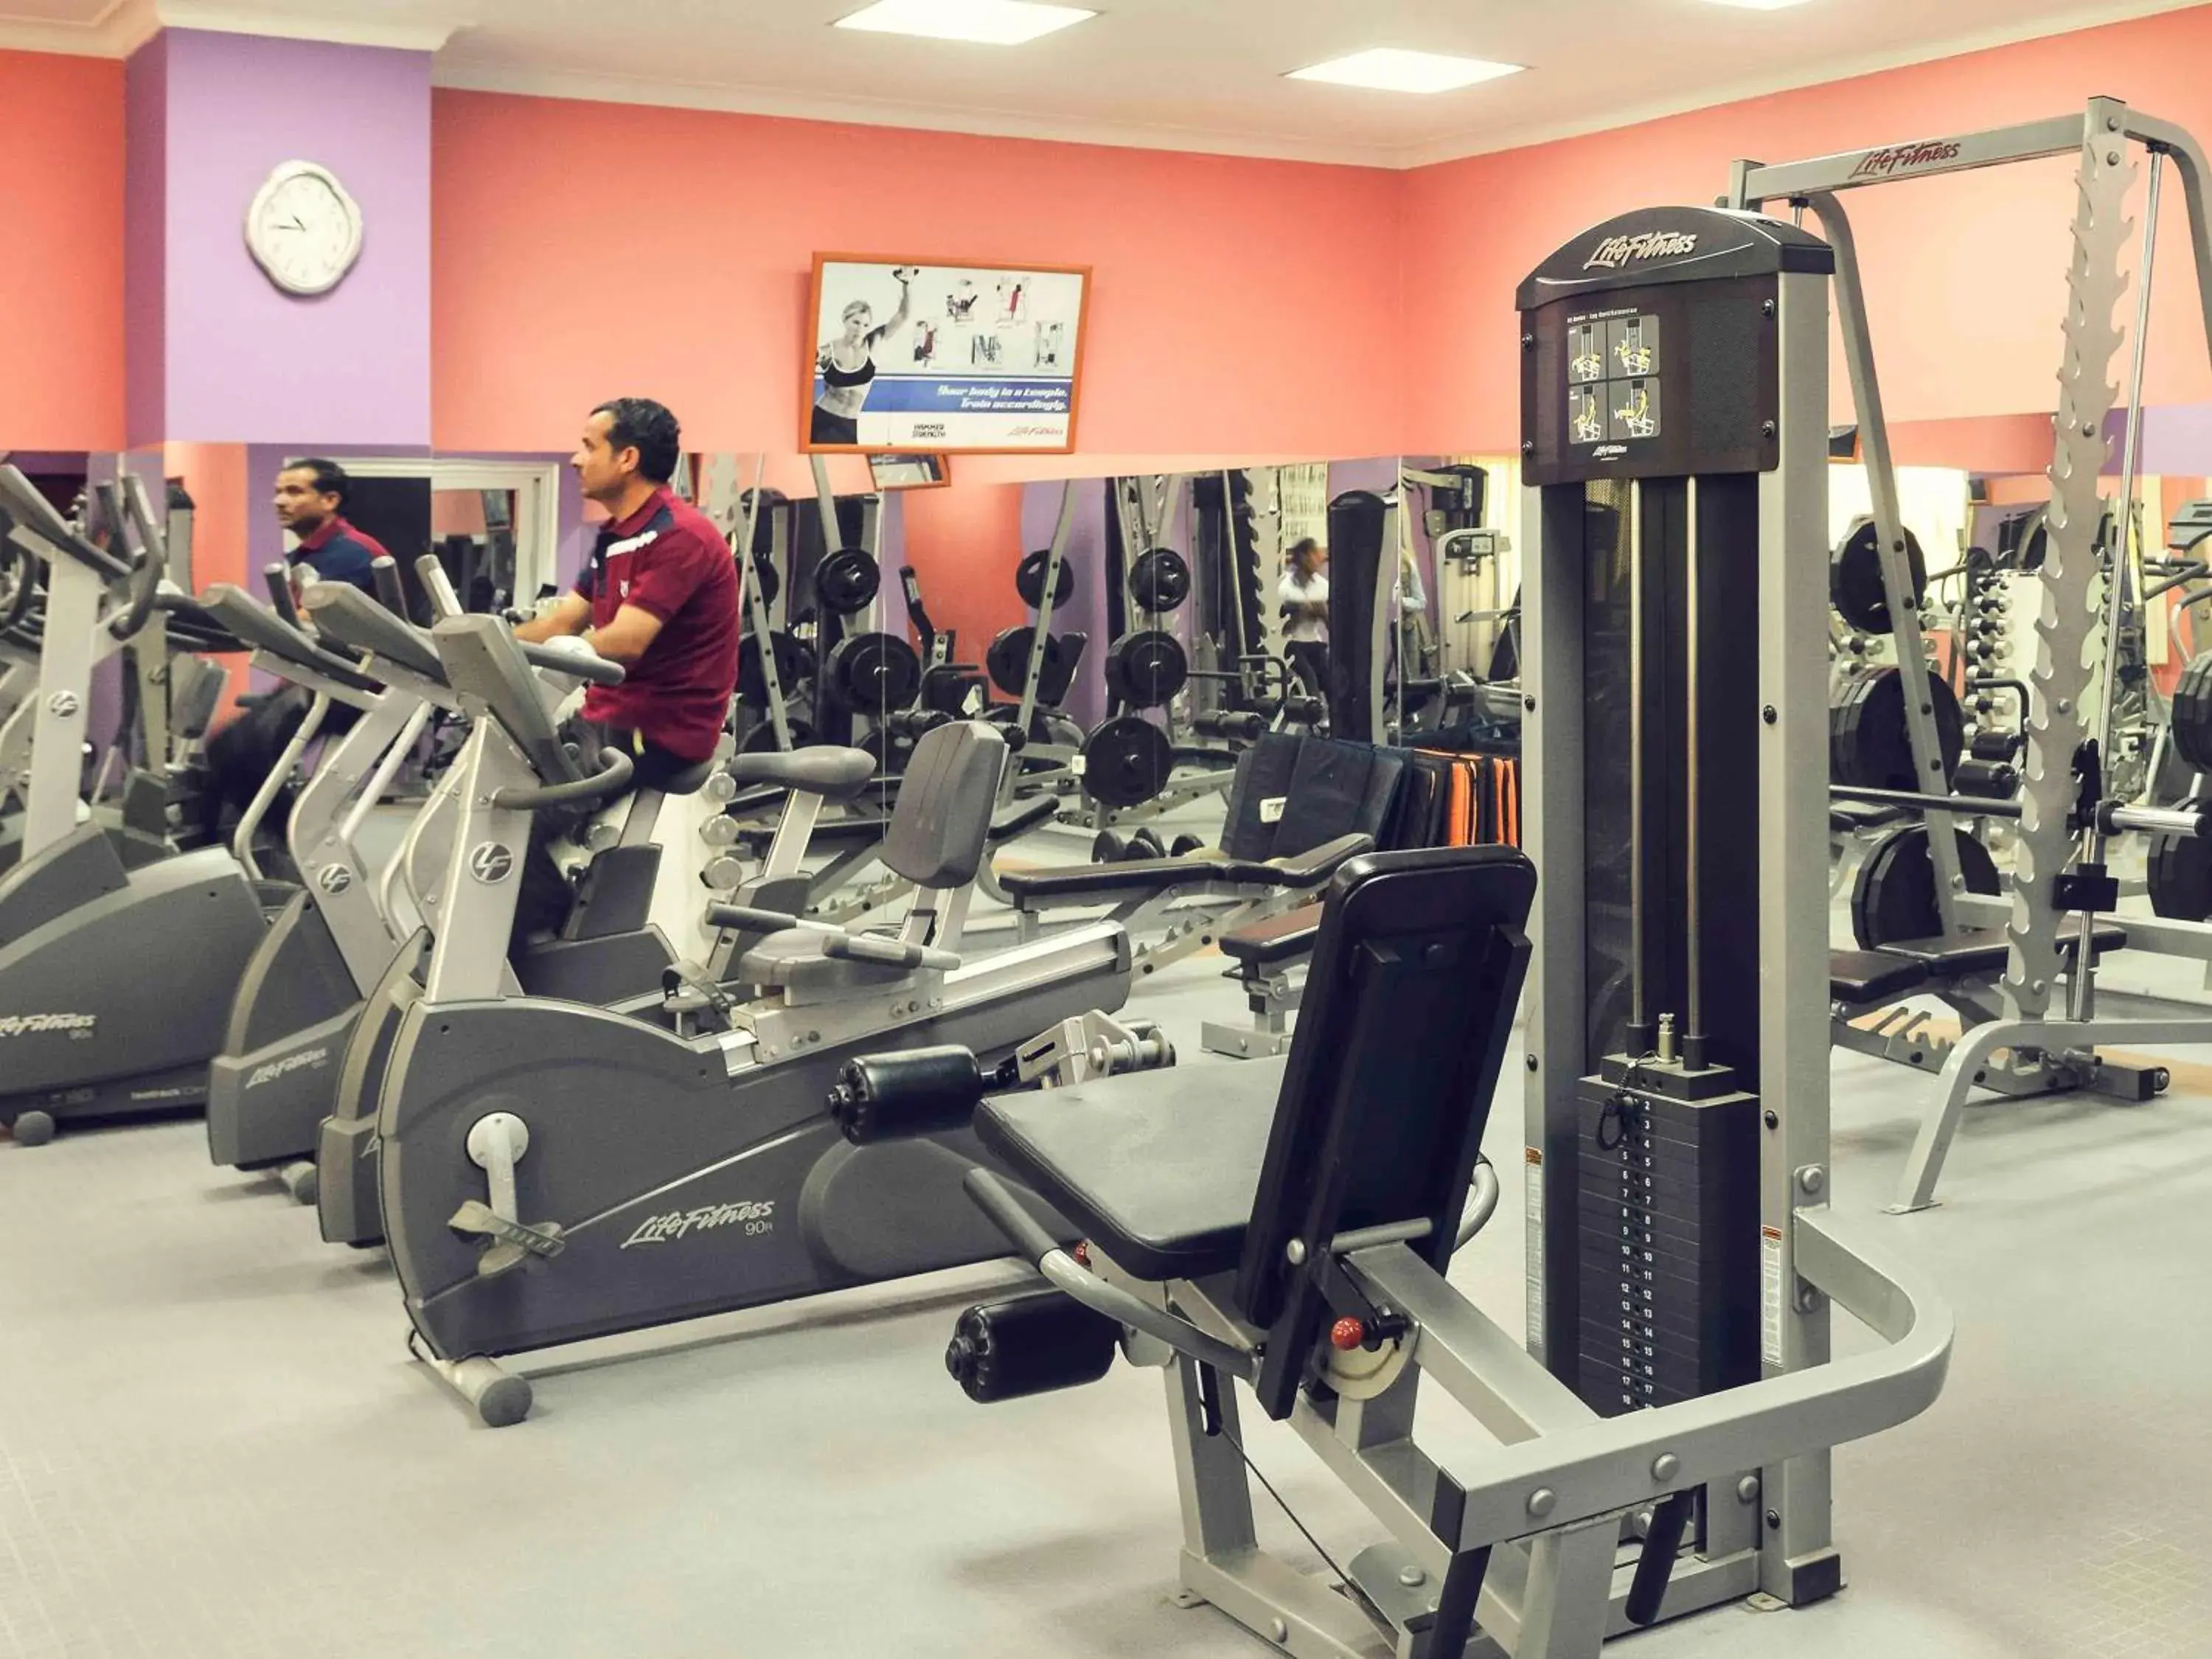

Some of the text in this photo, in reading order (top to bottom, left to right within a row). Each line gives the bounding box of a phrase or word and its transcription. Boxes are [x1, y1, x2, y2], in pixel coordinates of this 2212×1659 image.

[1644, 1101, 1650, 1111] 2
[1644, 1120, 1650, 1130] 3
[1644, 1139, 1650, 1149] 4
[1645, 1158, 1651, 1167] 5
[1645, 1177, 1651, 1187] 6
[1645, 1195, 1651, 1205] 7
[1645, 1215, 1651, 1225] 8
[1645, 1234, 1651, 1242] 9
[1644, 1252, 1652, 1262] 10
[1644, 1270, 1652, 1280] 11
[1644, 1290, 1652, 1300] 12
[1644, 1309, 1652, 1318] 13
[1644, 1327, 1652, 1338] 14
[1644, 1346, 1652, 1357] 15
[1644, 1366, 1652, 1376] 16
[1644, 1384, 1652, 1394] 17
